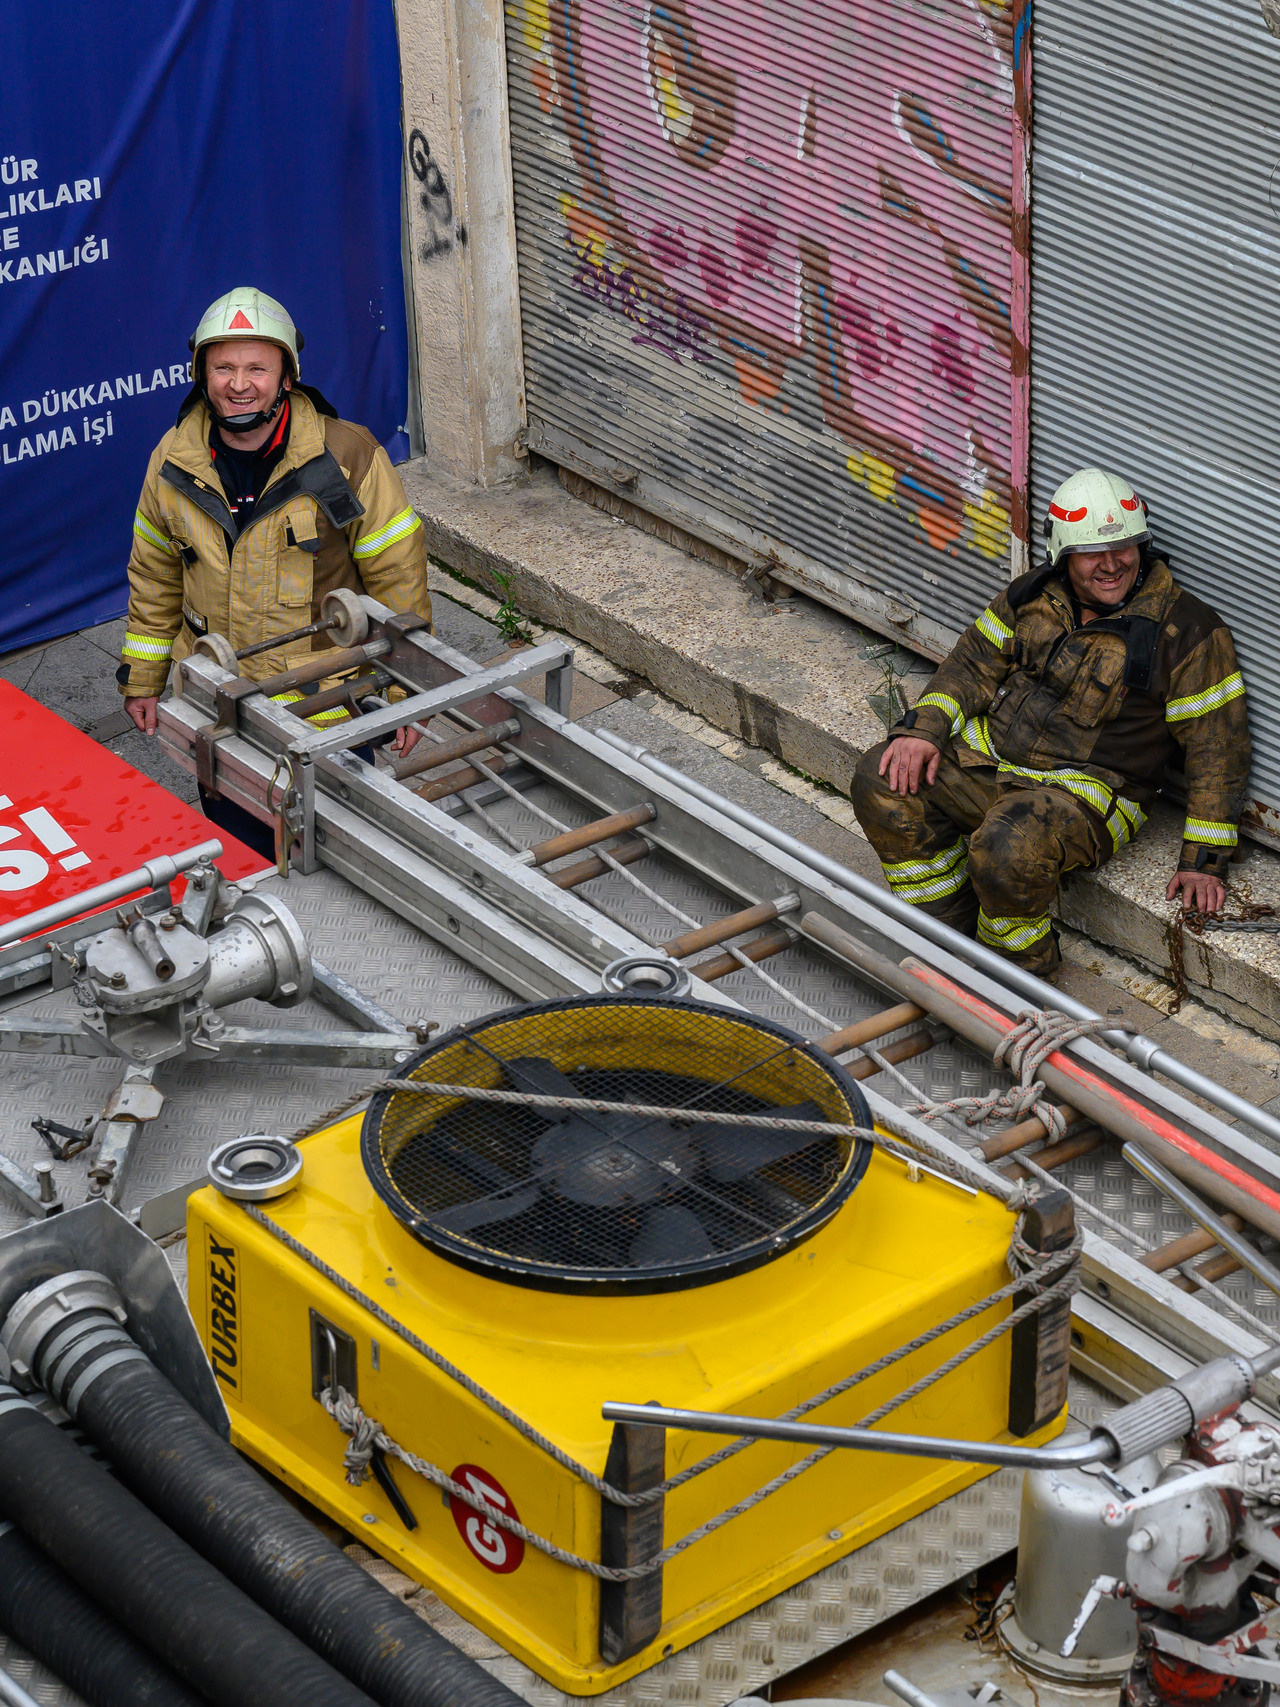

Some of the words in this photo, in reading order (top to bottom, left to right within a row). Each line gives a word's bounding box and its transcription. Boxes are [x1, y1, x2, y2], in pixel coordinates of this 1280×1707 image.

[0, 426, 77, 465] LAMA
[83, 410, 114, 446] İŞİ
[209, 1232, 238, 1389] TURBEX
